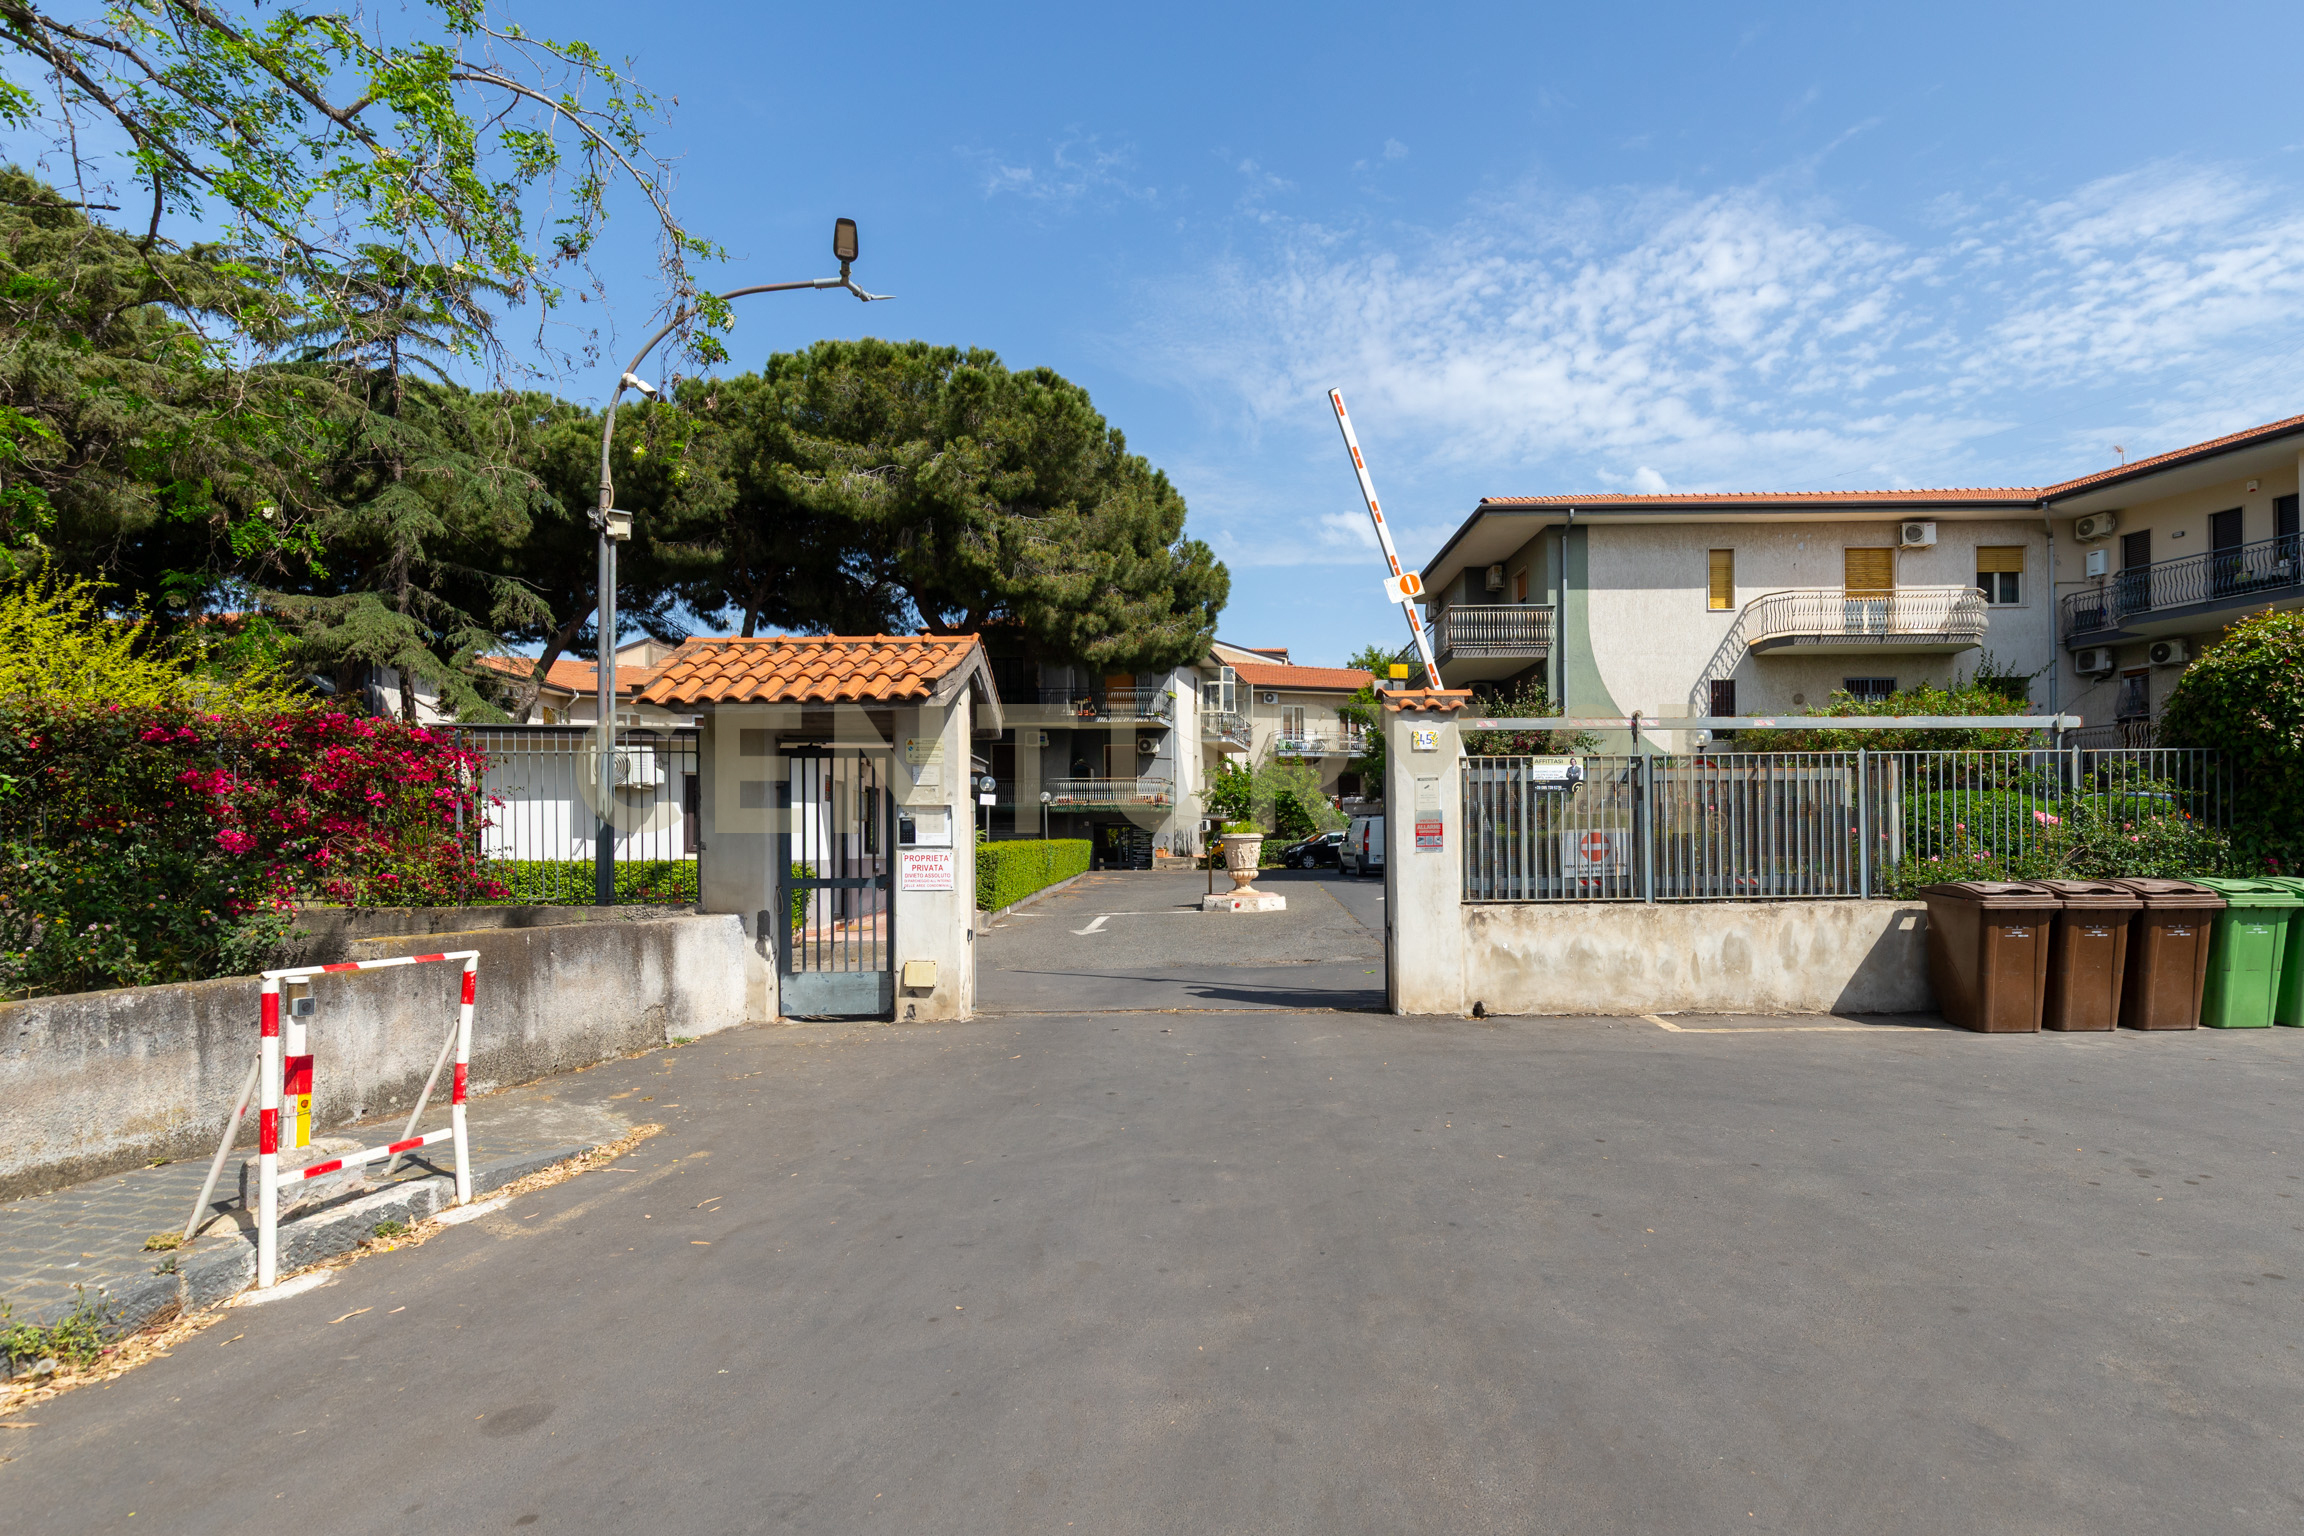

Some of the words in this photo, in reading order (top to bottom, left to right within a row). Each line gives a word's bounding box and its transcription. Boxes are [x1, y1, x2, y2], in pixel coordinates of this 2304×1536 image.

[1419, 733, 1432, 745] 45
[904, 854, 952, 862] PROPRIETA'
[911, 864, 944, 872] PRIVATA
